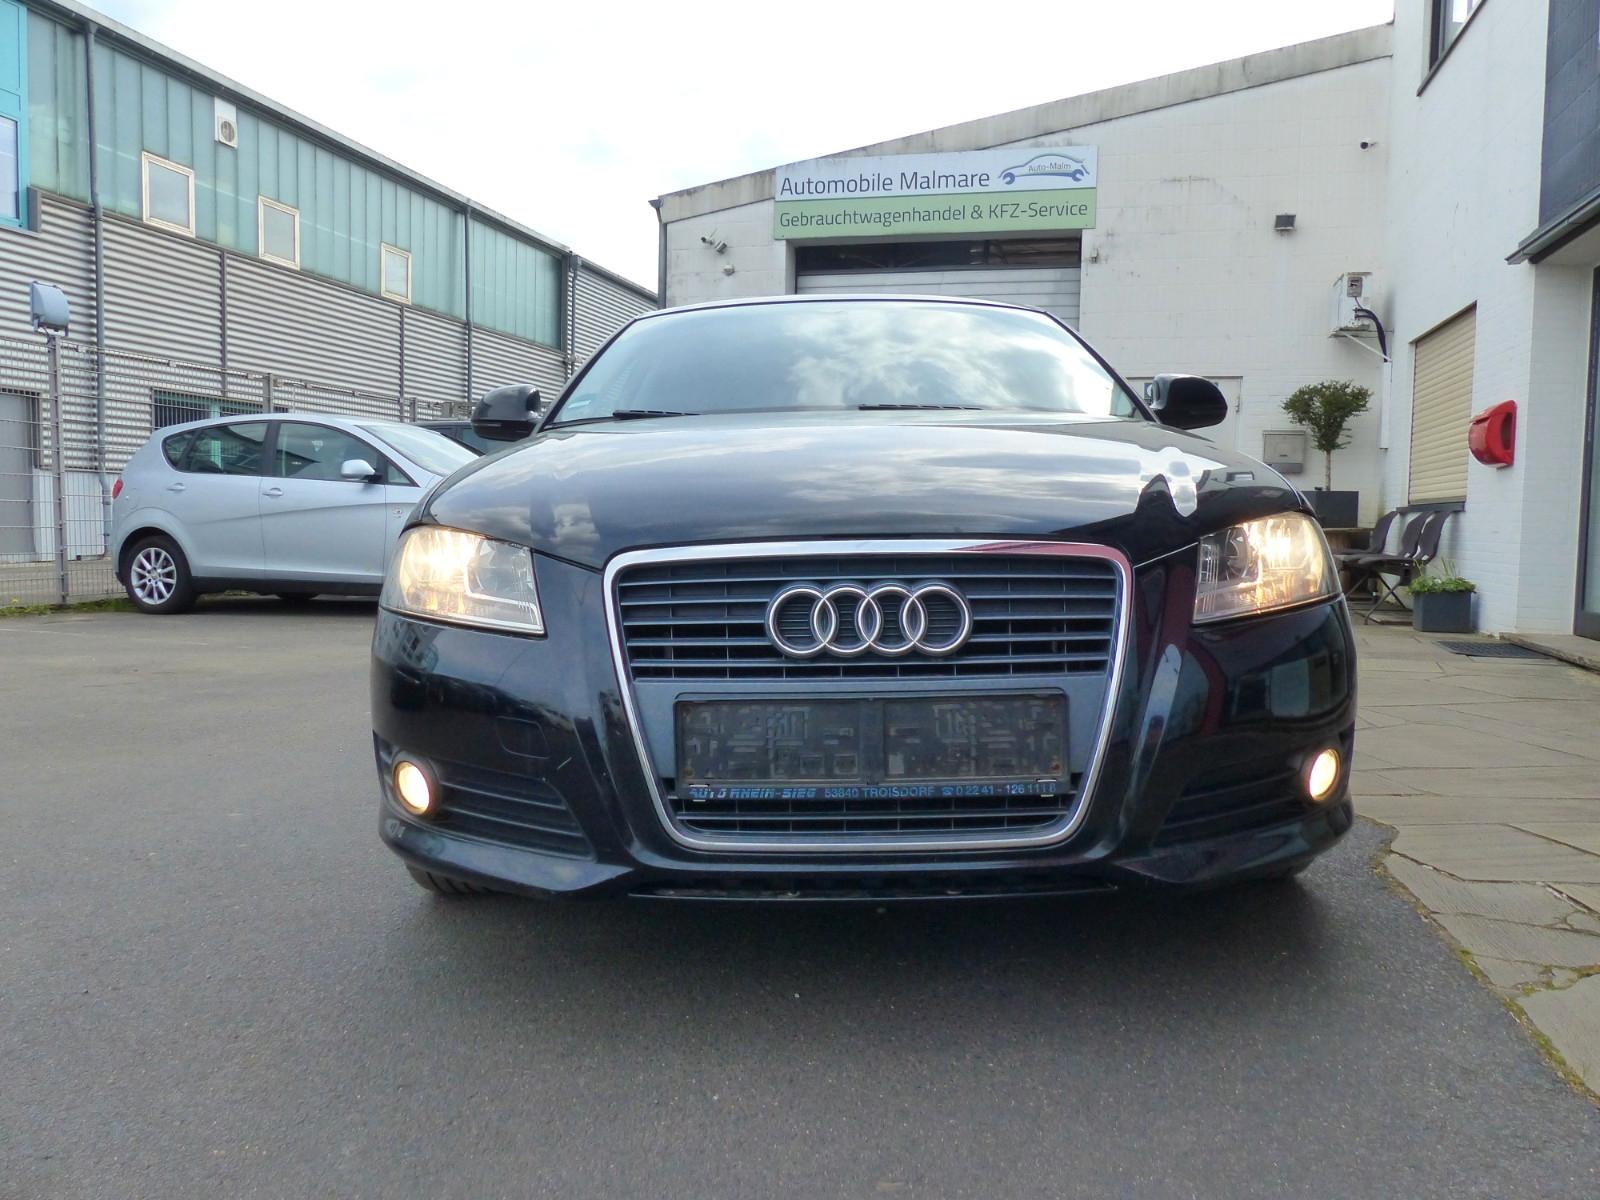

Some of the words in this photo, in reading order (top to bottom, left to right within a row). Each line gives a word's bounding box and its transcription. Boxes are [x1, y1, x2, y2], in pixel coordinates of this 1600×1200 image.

[1028, 161, 1072, 173] Auto-Malm
[780, 173, 893, 196] Automobile
[900, 170, 990, 191] Malmare
[780, 204, 966, 228] Gebrauchtwagenhandel
[970, 204, 984, 220] &
[989, 201, 1089, 219] KFZ-Service
[824, 787, 860, 799] 53840
[863, 785, 936, 799] TROISDORF
